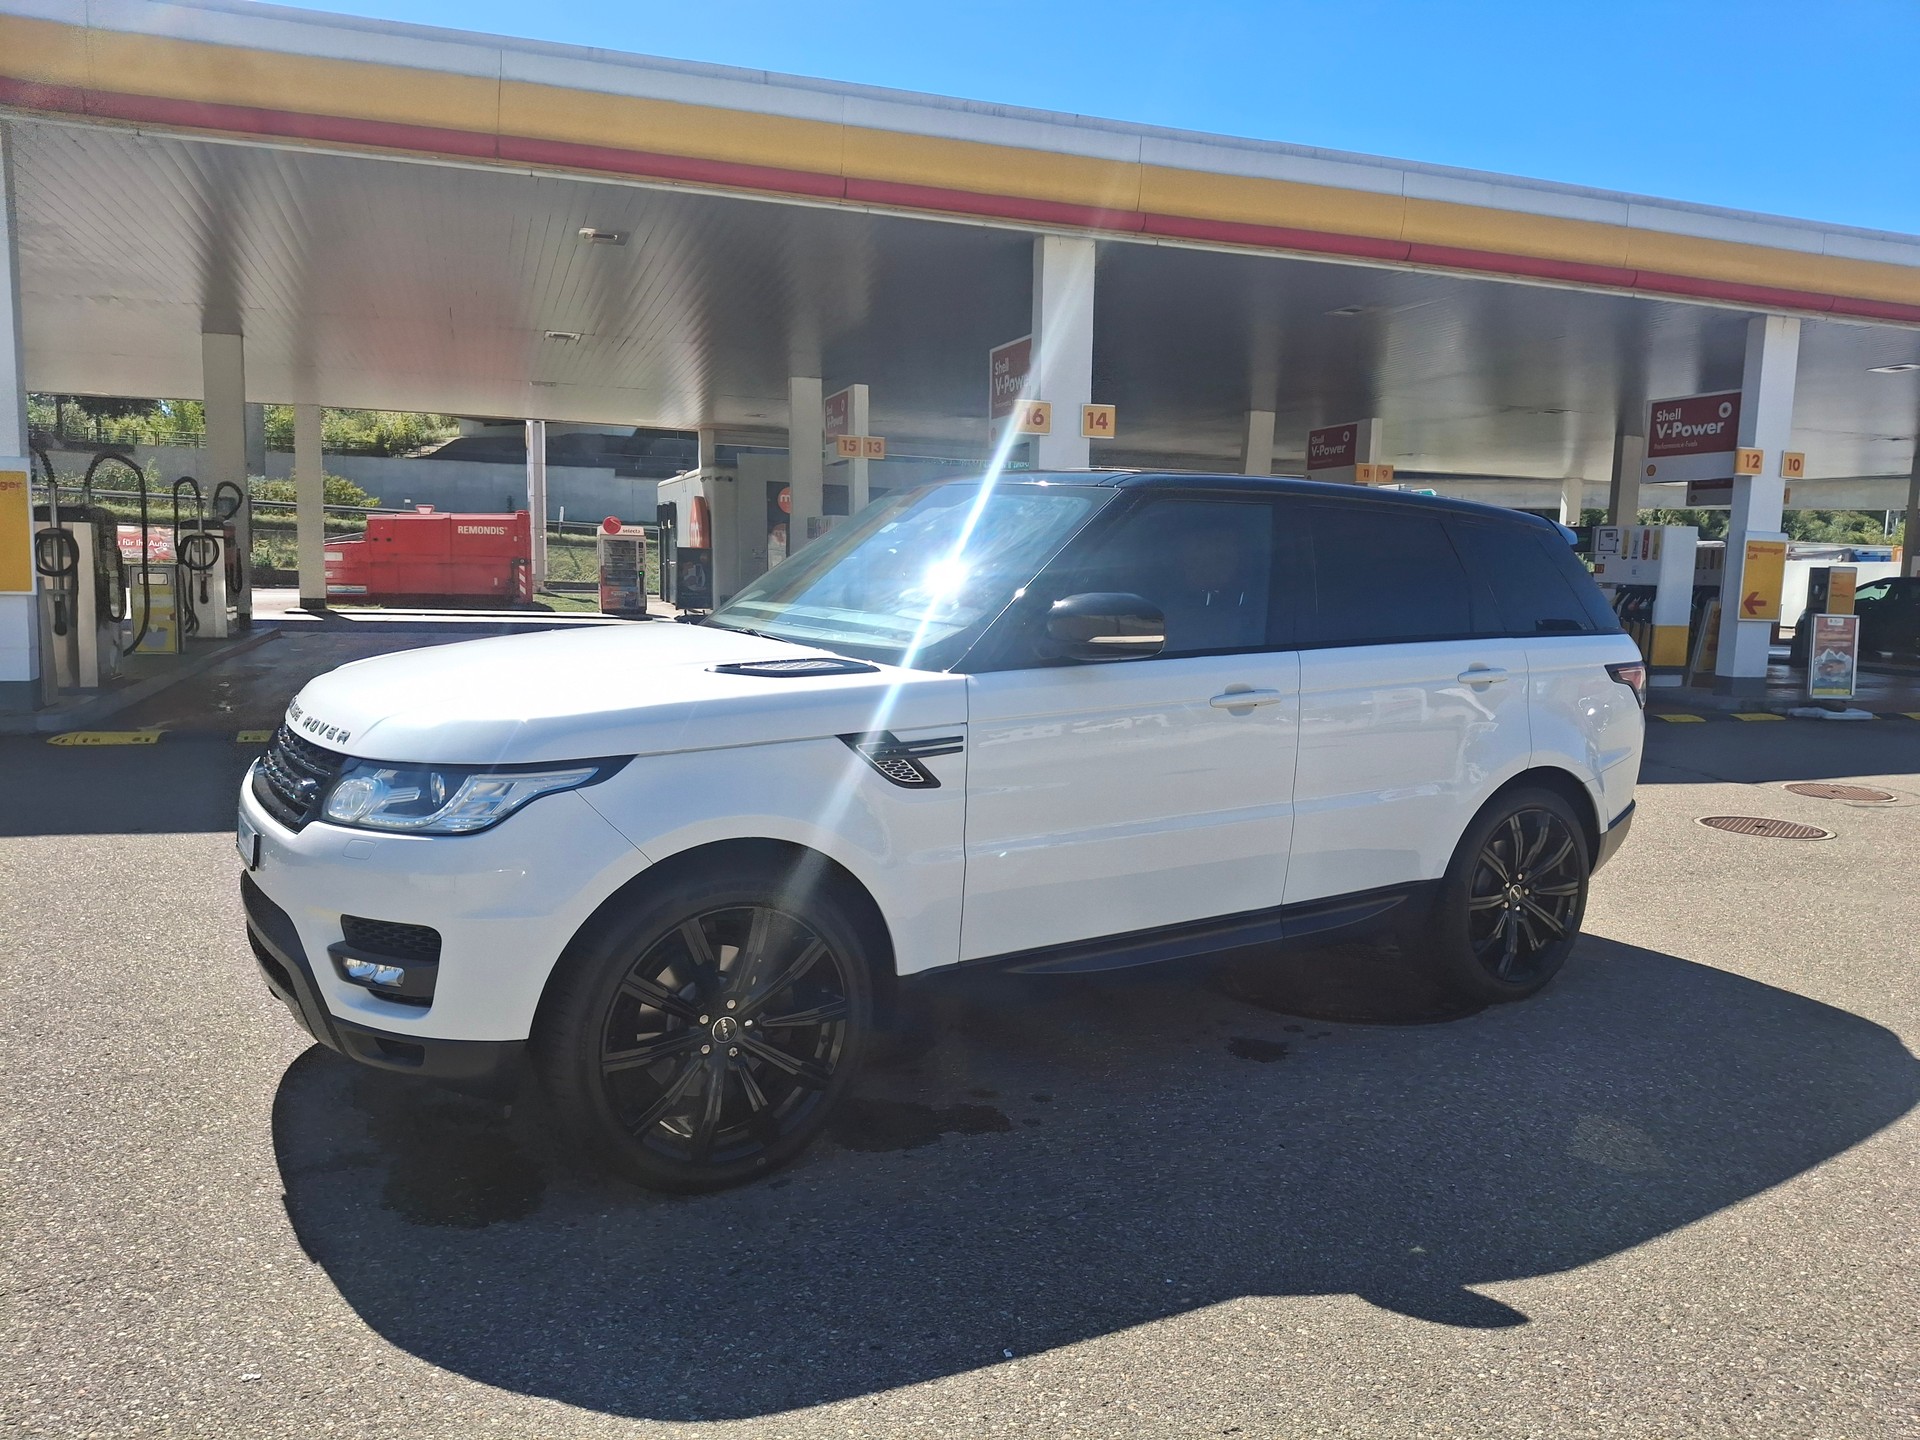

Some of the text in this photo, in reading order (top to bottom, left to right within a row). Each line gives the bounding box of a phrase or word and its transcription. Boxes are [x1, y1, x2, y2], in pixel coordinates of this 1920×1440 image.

[995, 357, 1009, 376] Shell
[995, 373, 1031, 396] V-Powe
[1025, 408, 1045, 426] 16
[1087, 411, 1109, 430] 14
[1656, 408, 1682, 422] Shell
[1656, 421, 1725, 439] V-Power
[842, 440, 857, 452] 15
[867, 441, 882, 453] 13
[1311, 444, 1346, 457] V-Power
[1745, 454, 1760, 468] 12
[1788, 458, 1801, 471] 10
[1382, 470, 1388, 478] 9
[457, 525, 505, 535] REMONDIS
[122, 537, 135, 546] für
[148, 539, 170, 548] Auto.
[303, 716, 351, 745] ROVER
